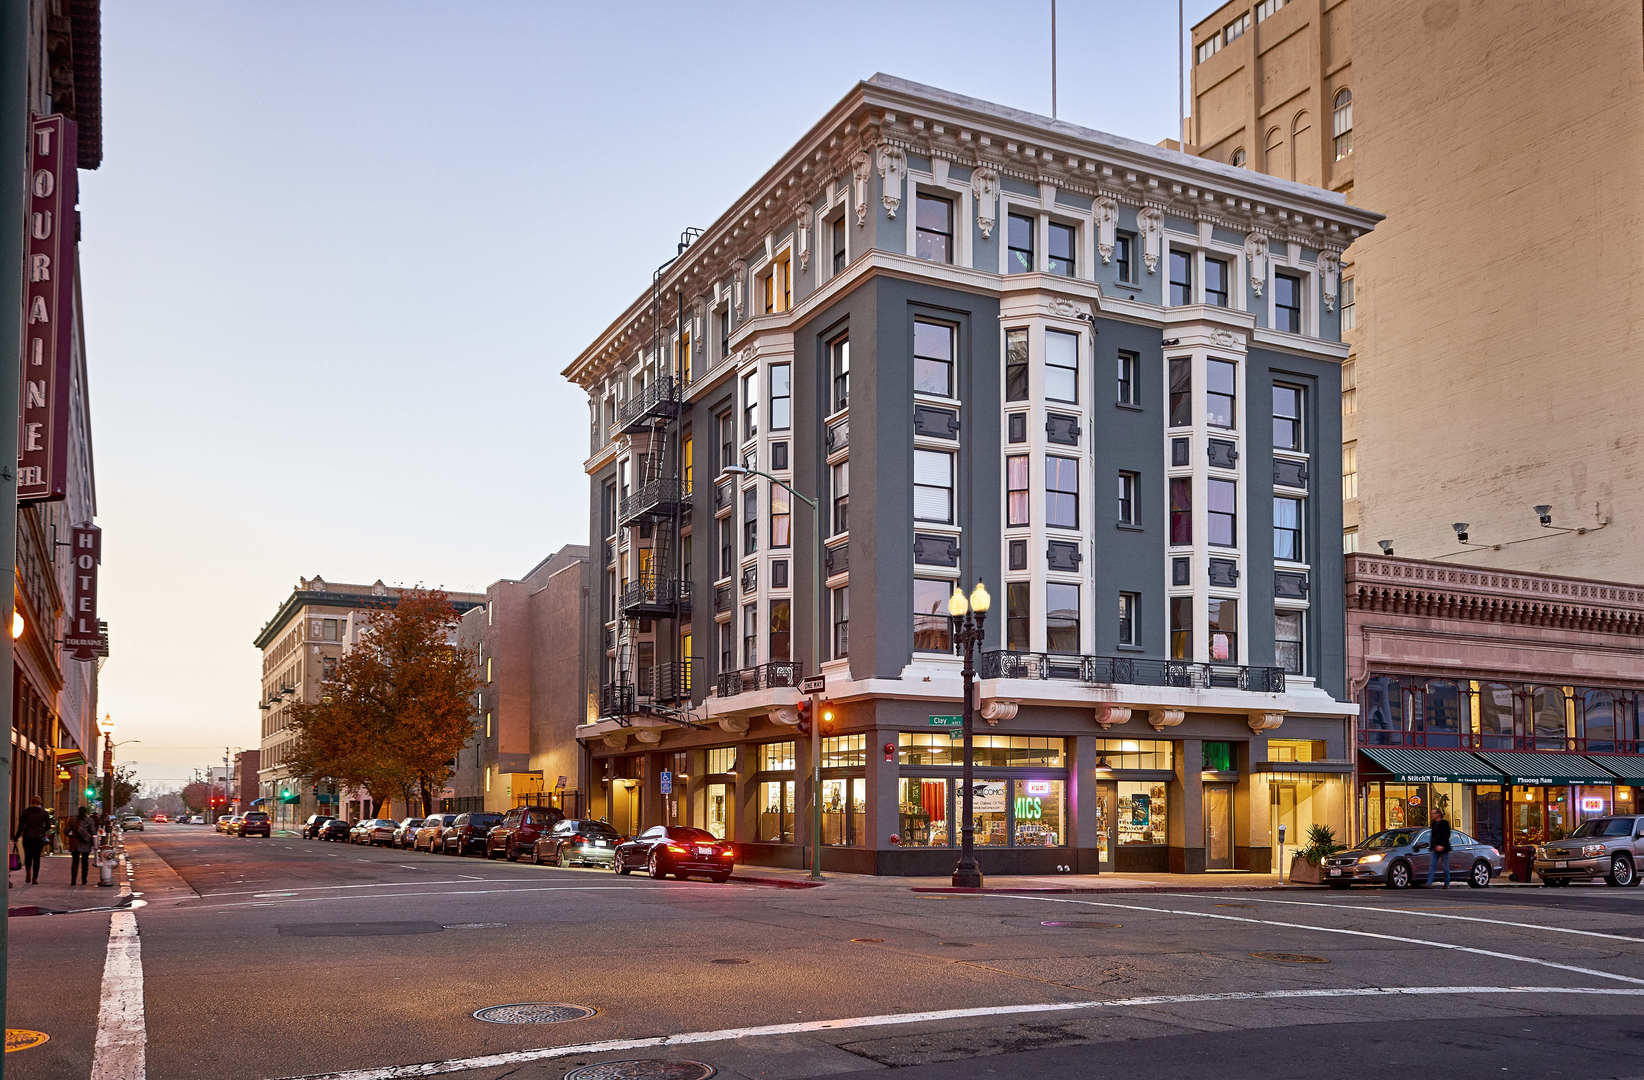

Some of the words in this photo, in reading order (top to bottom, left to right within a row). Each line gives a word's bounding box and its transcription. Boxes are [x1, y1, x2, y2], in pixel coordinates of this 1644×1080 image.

[25, 126, 55, 452] TOURAINE
[78, 533, 93, 633] HOTEL
[66, 638, 104, 647] TOURAINE
[933, 717, 947, 725] Clay
